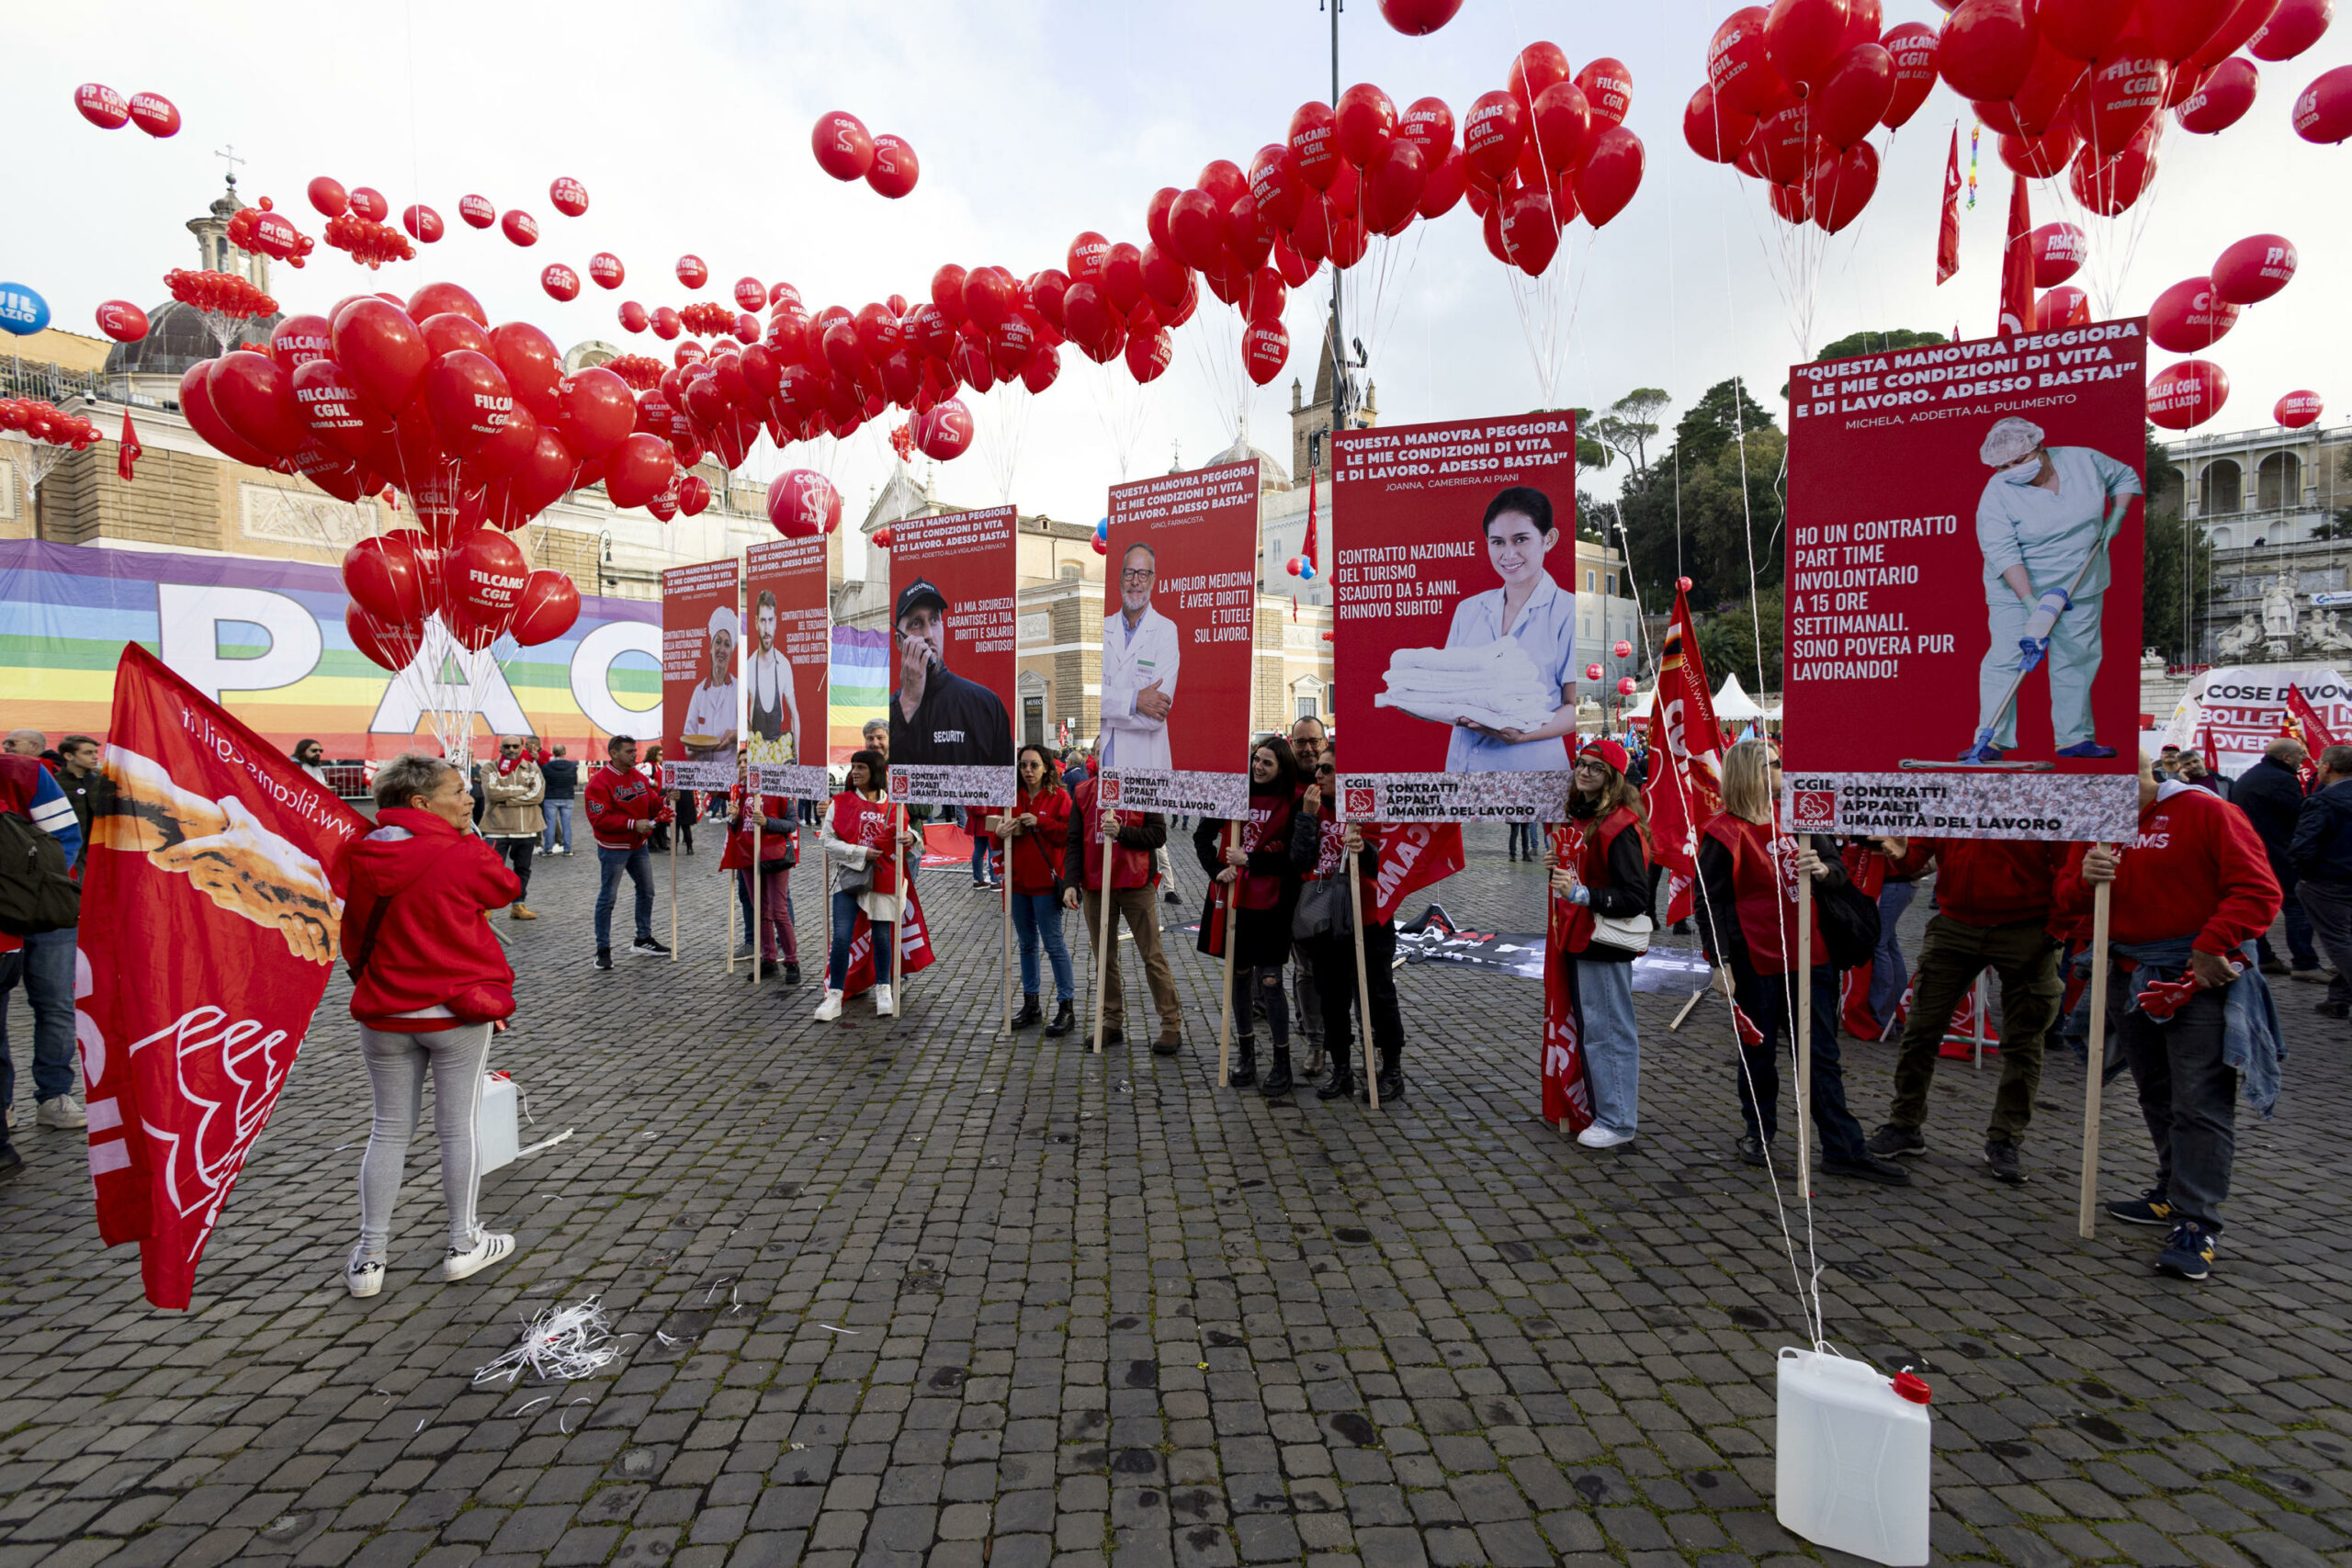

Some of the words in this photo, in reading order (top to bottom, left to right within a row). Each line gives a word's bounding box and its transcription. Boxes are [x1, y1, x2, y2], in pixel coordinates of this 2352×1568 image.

[82, 85, 96, 97] FP
[1602, 94, 1624, 110] CGIL
[834, 118, 857, 131] CGIL
[1469, 121, 1493, 141] CGIL
[874, 139, 899, 148] CGIL
[1293, 127, 1332, 148] FILCAMS
[1483, 134, 1504, 145] LAZIO
[837, 143, 854, 152] FLAI
[1303, 140, 1326, 155] CGIL
[555, 189, 586, 207] CGIL
[2265, 246, 2284, 265] FP
[546, 276, 572, 289] CGIL
[1261, 342, 1280, 355] CGIL
[1797, 356, 1893, 383] "QUESTA
[1894, 341, 2007, 369] MANOVRA
[2014, 322, 2140, 353] PEGGIORA
[1812, 382, 1835, 398] LE
[1841, 376, 1878, 394] MIE
[1884, 357, 2018, 389] CONDIZIONI
[2021, 354, 2050, 371] DI
[2057, 345, 2113, 367] VITA
[1796, 403, 1809, 418] E
[1815, 400, 1836, 416] DI
[1841, 387, 1936, 412] LAVORO.
[1942, 375, 2032, 400] ADESSO
[2038, 361, 2138, 389] BASTA!"
[2177, 378, 2201, 393] CGIL
[2175, 394, 2201, 408] LAZIO
[313, 403, 350, 418] CGIL
[1845, 413, 1905, 430] MICHELA,
[1909, 406, 1971, 423] ADDETTA
[1973, 403, 1991, 415] AL
[1994, 393, 2076, 412] PULIMENTO
[337, 419, 363, 429] LAZIO
[938, 431, 960, 442] FLAI
[1335, 435, 1400, 453] "QUESTA
[1405, 428, 1482, 446] MANOVRA
[1487, 420, 1568, 439] PEGGIORA
[1347, 454, 1363, 467] LE
[1368, 451, 1394, 465] MIE
[1398, 443, 1489, 462] CONDIZIONI
[1495, 441, 1511, 454] DI
[1516, 437, 1552, 452] VITA
[1336, 470, 1344, 482] E
[1349, 469, 1364, 481] DI
[1369, 463, 1434, 479] LAVORO.
[1439, 457, 1499, 474] ADESSO
[1504, 452, 1568, 468] BASTA!"
[1111, 484, 1149, 500] "QUESTA
[1152, 475, 1199, 492] MANOVRA
[1202, 466, 1255, 484] PEGGIORA
[1385, 481, 1424, 491] JOANNA,
[1428, 477, 1481, 489] CAMERIERA
[1483, 476, 1493, 484] AI
[1494, 473, 1519, 483] PIANI
[1116, 501, 1126, 511] LE
[1129, 498, 1145, 509] MIE
[1148, 488, 1204, 506] CONDIZIONI
[1206, 486, 1217, 496] DI
[1221, 481, 1243, 494] VITA
[1110, 515, 1114, 525] E
[1117, 513, 1126, 524] DI
[1128, 506, 1169, 522] LAVORO.
[1171, 500, 1209, 515] ADESSO
[1212, 493, 1254, 509] BASTA!"
[1796, 526, 1818, 546] HO
[1825, 525, 1847, 543] UN
[1853, 514, 1957, 541] CONTRATTO
[1339, 546, 1407, 565] CONTRATTO
[1410, 541, 1476, 560] NAZIONALE
[1795, 547, 1838, 569] PART
[1843, 544, 1885, 565] TIME
[469, 570, 524, 590] FILCAMS
[1159, 580, 1169, 593] LA
[1171, 575, 1205, 592] MIGLIOR
[1209, 571, 1252, 588] MEDICINA
[1339, 568, 1360, 583] DEL
[1363, 564, 1416, 581] TURISMO
[1794, 565, 1918, 591] INVOLONTARIO
[481, 587, 512, 602] CGIL
[907, 582, 934, 596] SECURITY
[1339, 584, 1392, 602] SCADUTO
[1396, 582, 1412, 598] DA
[1416, 582, 1422, 595] 5
[1427, 580, 1461, 595] ANNI.
[469, 595, 492, 607] ROMA
[955, 603, 963, 614] LA
[964, 601, 977, 612] MIA
[978, 597, 1014, 611] SICUREZZA
[1181, 591, 1185, 609] È
[1187, 592, 1214, 607] AVERE
[1216, 590, 1249, 605] DIRITTI
[1793, 595, 1804, 614] A
[1809, 593, 1829, 612] 15
[1836, 592, 1869, 611] ORE
[1212, 610, 1216, 624] E
[1219, 608, 1251, 624] TUTELE
[1340, 602, 1391, 620] RINNOVO
[1395, 600, 1442, 616] SUBITO!
[947, 615, 988, 627] GARANTISCE
[989, 615, 997, 624] LA
[999, 612, 1014, 623] TUA.
[1793, 613, 1909, 636] SETTIMANALI.
[956, 629, 978, 640] DIRITTI
[980, 627, 984, 638] E
[986, 626, 1014, 638] SALARIO
[1195, 628, 1210, 643] SUL
[1213, 626, 1250, 641] LAVORO.
[976, 640, 1014, 652] DIGNITOSO!
[1793, 638, 1838, 658] SONO
[1845, 636, 1912, 657] POVERA
[1918, 634, 1955, 654] PUR
[1792, 660, 1898, 681] LAVORANDO!
[2207, 684, 2272, 701] COSE
[933, 730, 965, 743] SECURITY
[1345, 779, 1374, 788] CGIL
[1386, 784, 1459, 793] CONTRATTI
[1793, 779, 1835, 791] CGIL
[1842, 785, 1948, 799] CONTRATTI
[1386, 795, 1441, 805] APPALTI
[1842, 800, 1920, 812] APPALTI
[1386, 804, 1446, 817] UMANITÀ
[1450, 807, 1475, 816] DEL
[1479, 807, 1535, 816] LAVORO
[1793, 818, 1834, 827] FILCAMS
[1842, 813, 1928, 827] UMANITÀ
[1934, 817, 1971, 829] DEL
[1976, 818, 2063, 830] LAVORO
